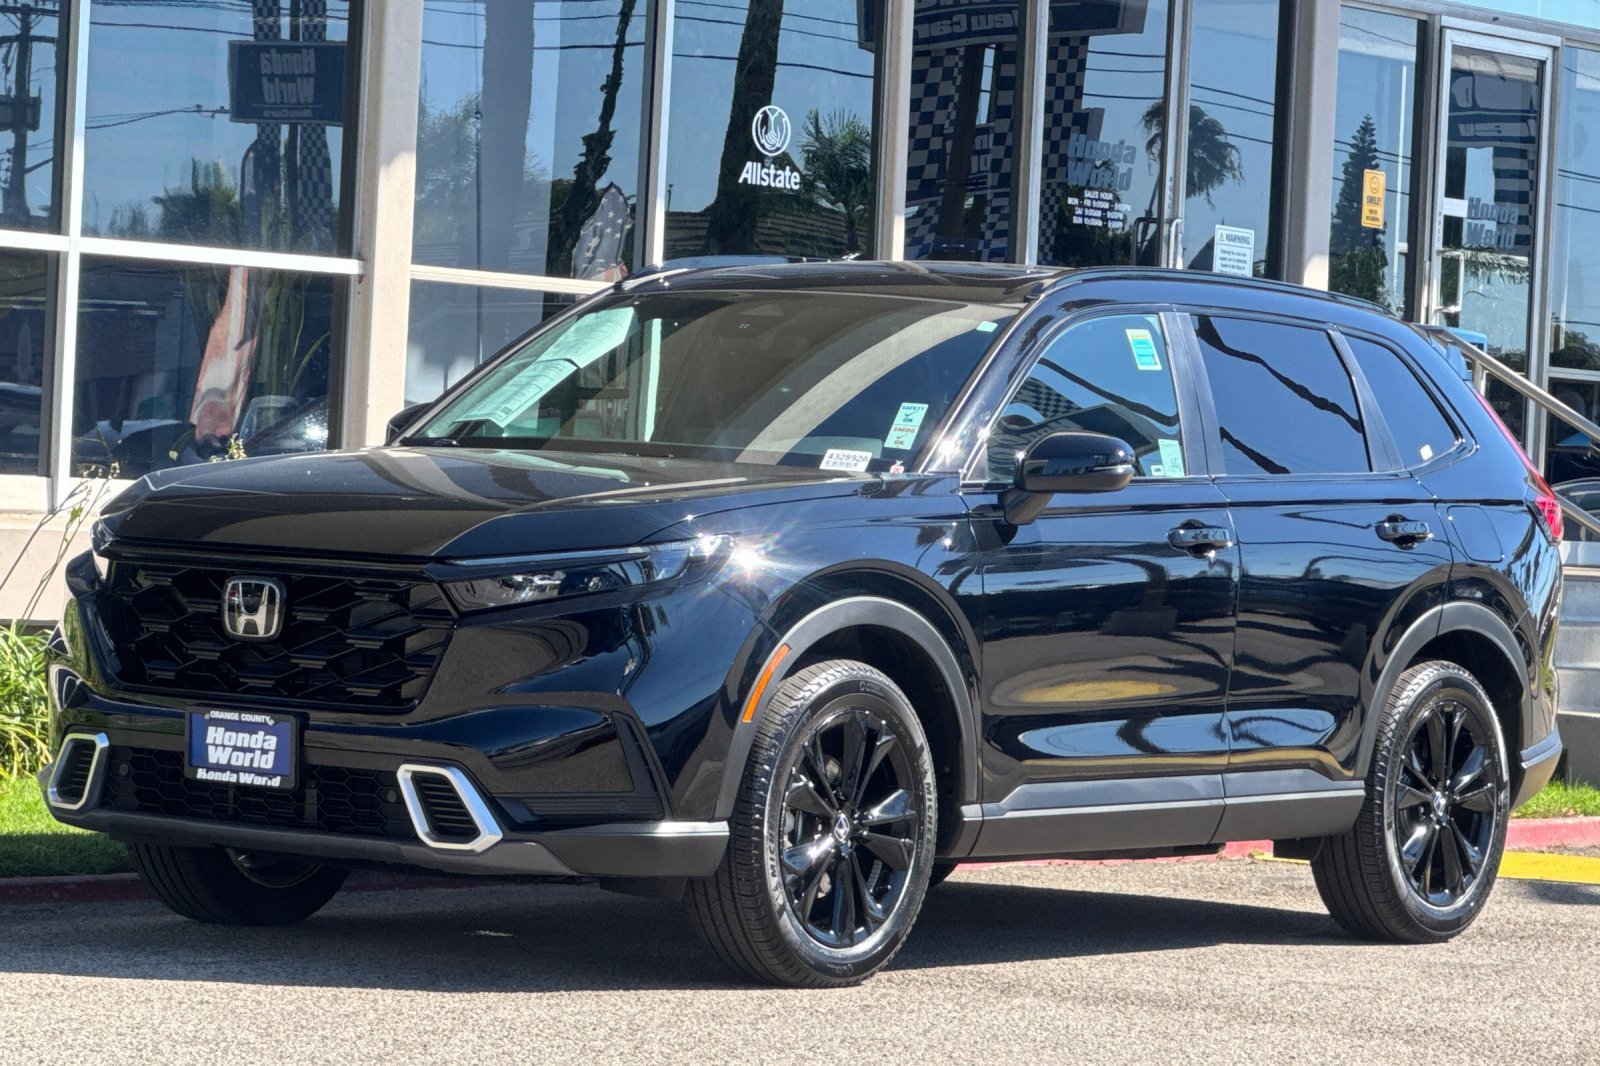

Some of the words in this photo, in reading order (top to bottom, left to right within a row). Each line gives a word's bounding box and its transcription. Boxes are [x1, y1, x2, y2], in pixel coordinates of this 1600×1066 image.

[1067, 132, 1137, 165] Honda
[738, 160, 801, 190] Allstate
[1066, 160, 1133, 191] World
[1083, 189, 1099, 199] SALES
[1467, 196, 1520, 225] Honda
[1226, 233, 1251, 246] WARNING
[1466, 221, 1517, 249] World
[828, 452, 868, 463] 432892A
[210, 710, 240, 721] ORANGE
[241, 713, 271, 723] COUNTY
[206, 726, 278, 750] Honda
[207, 744, 276, 770] World
[196, 767, 237, 783] Honda
[239, 771, 282, 787] World
